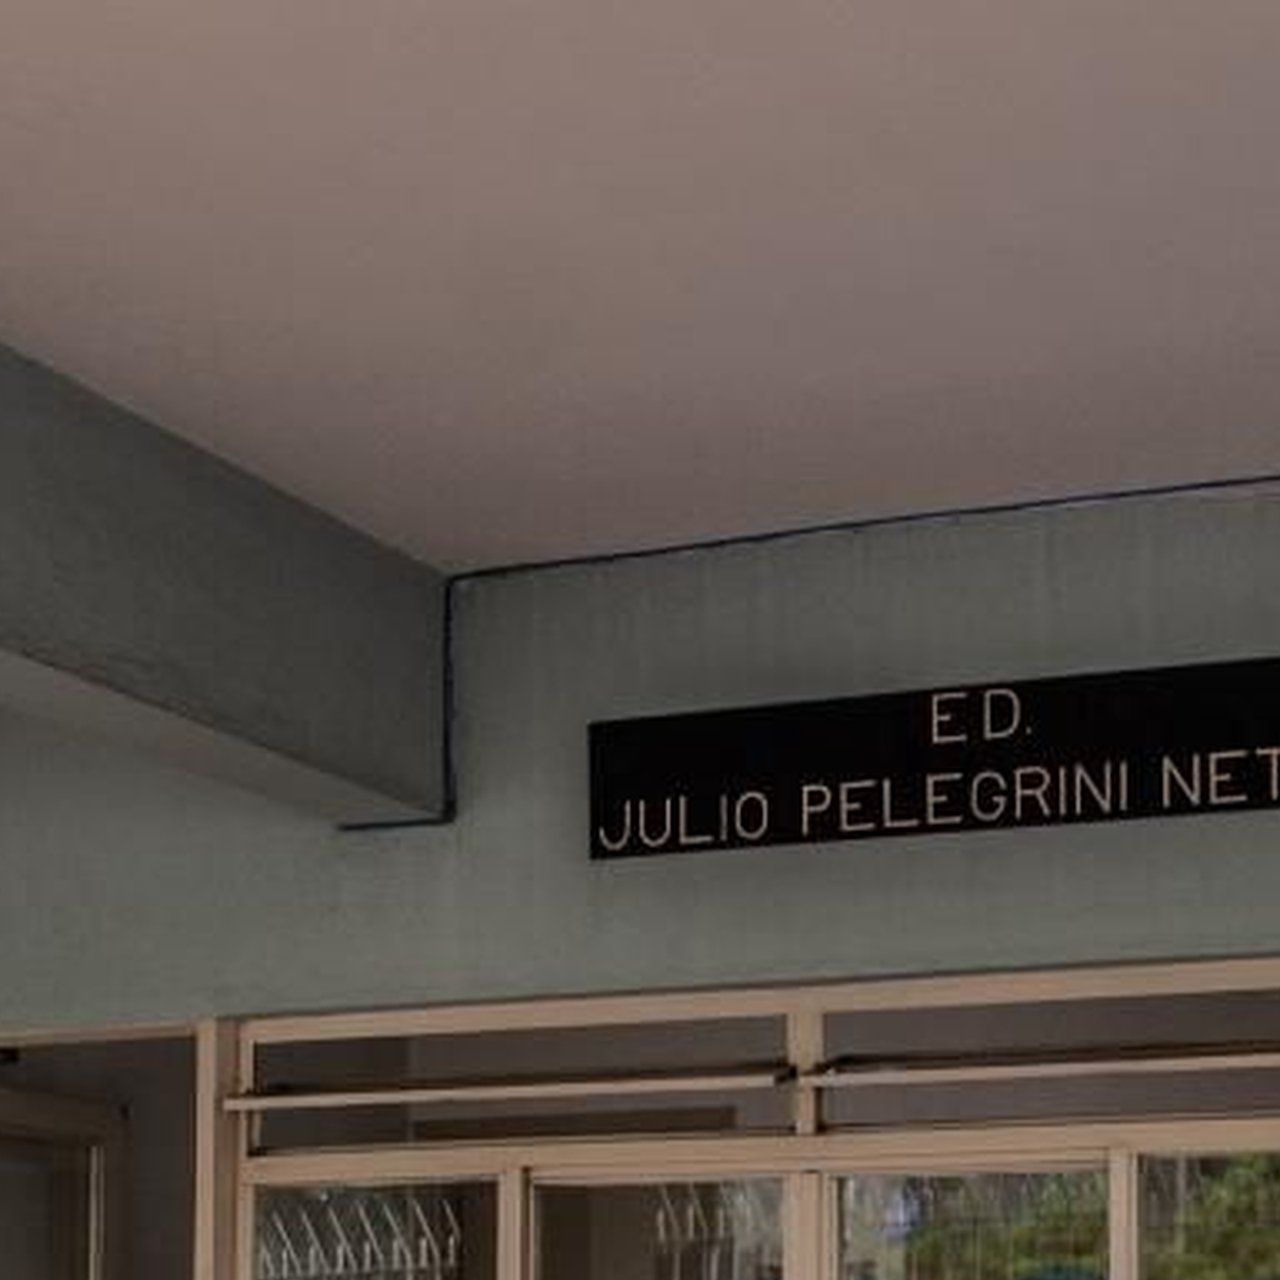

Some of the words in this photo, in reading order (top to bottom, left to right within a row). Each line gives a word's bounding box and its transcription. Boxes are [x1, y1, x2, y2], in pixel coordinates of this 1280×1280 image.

[931, 688, 1033, 744] ED.
[599, 791, 770, 851] JULIO
[801, 760, 1129, 836] PELEGRINI
